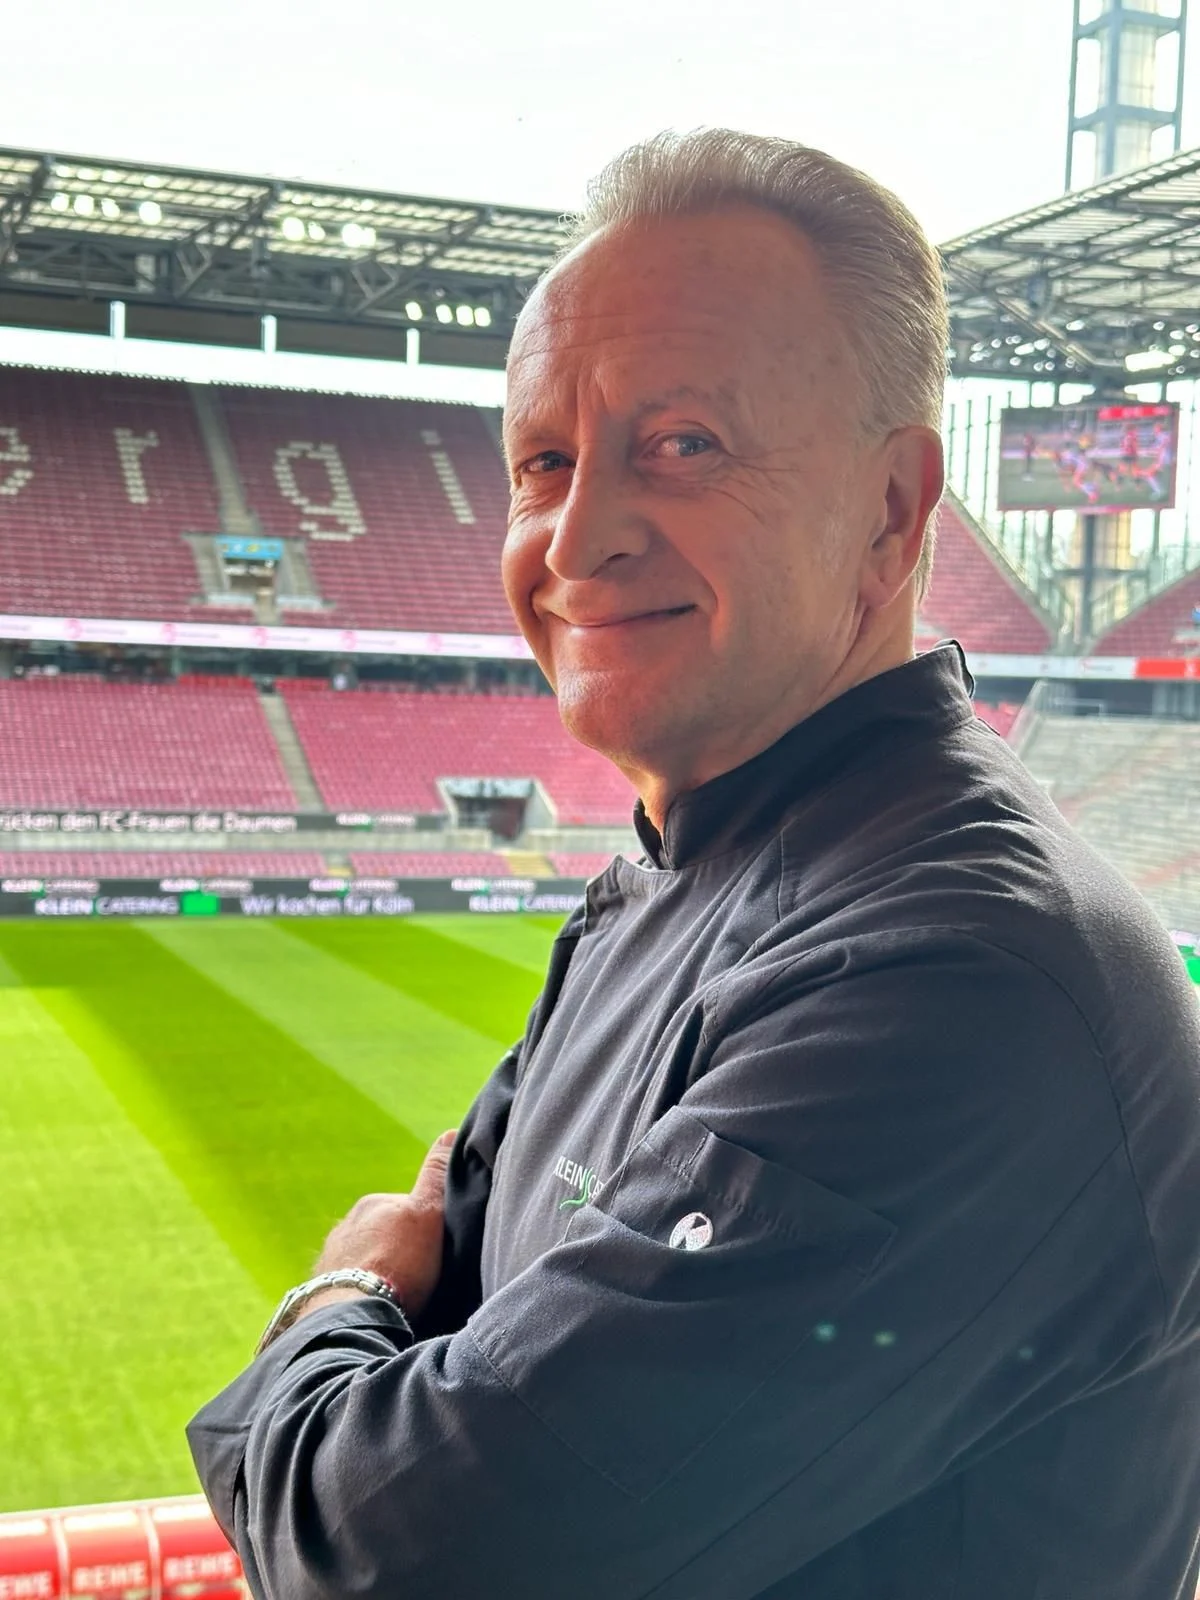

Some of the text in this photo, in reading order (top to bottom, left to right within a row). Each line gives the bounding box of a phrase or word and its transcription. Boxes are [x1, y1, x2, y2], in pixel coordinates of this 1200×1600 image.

[0, 811, 297, 831] ücken den FC-Frauen die Daumen
[35, 898, 93, 915] KLEIN
[240, 893, 414, 914] Wir kochen für Köln
[469, 896, 519, 912] KLEIN
[74, 1561, 147, 1591] REWE
[164, 1553, 235, 1581] REWE
